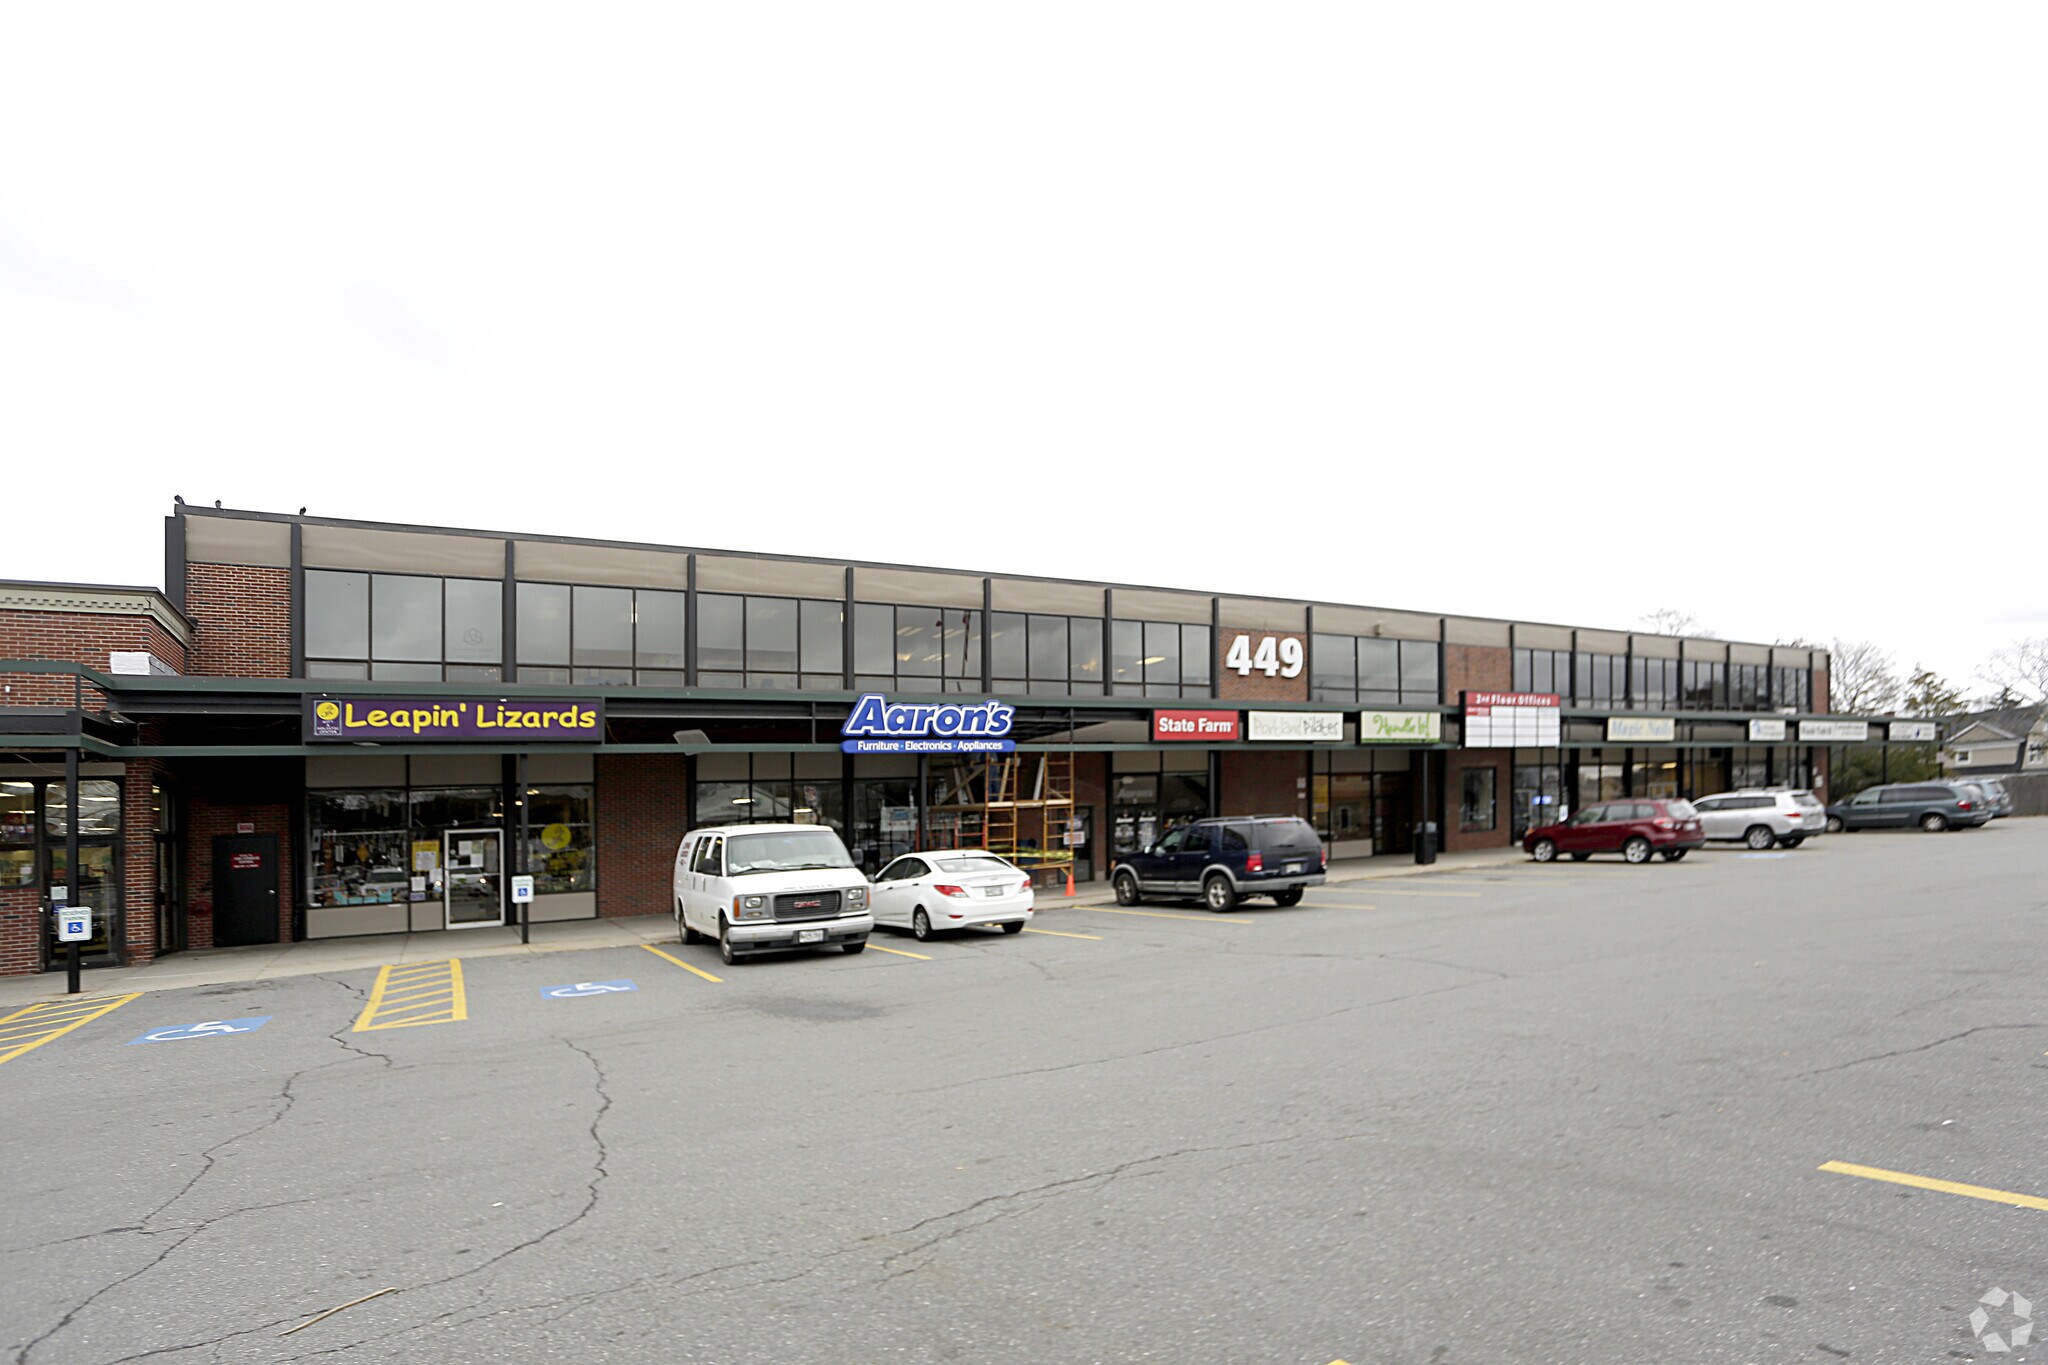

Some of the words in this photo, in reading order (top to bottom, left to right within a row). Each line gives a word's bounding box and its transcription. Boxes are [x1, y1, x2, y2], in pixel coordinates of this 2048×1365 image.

[1225, 634, 1304, 678] 449
[1491, 694, 1516, 705] Floor
[1517, 695, 1552, 706] Offices
[345, 702, 467, 734] Leapin'
[476, 704, 597, 728] Lizards
[842, 694, 1016, 736] Aaron's
[1158, 717, 1195, 732] State
[1197, 718, 1232, 732] Farm
[857, 740, 899, 751] Furniture
[905, 741, 952, 751] Electronics
[957, 741, 1003, 752] Appliances
